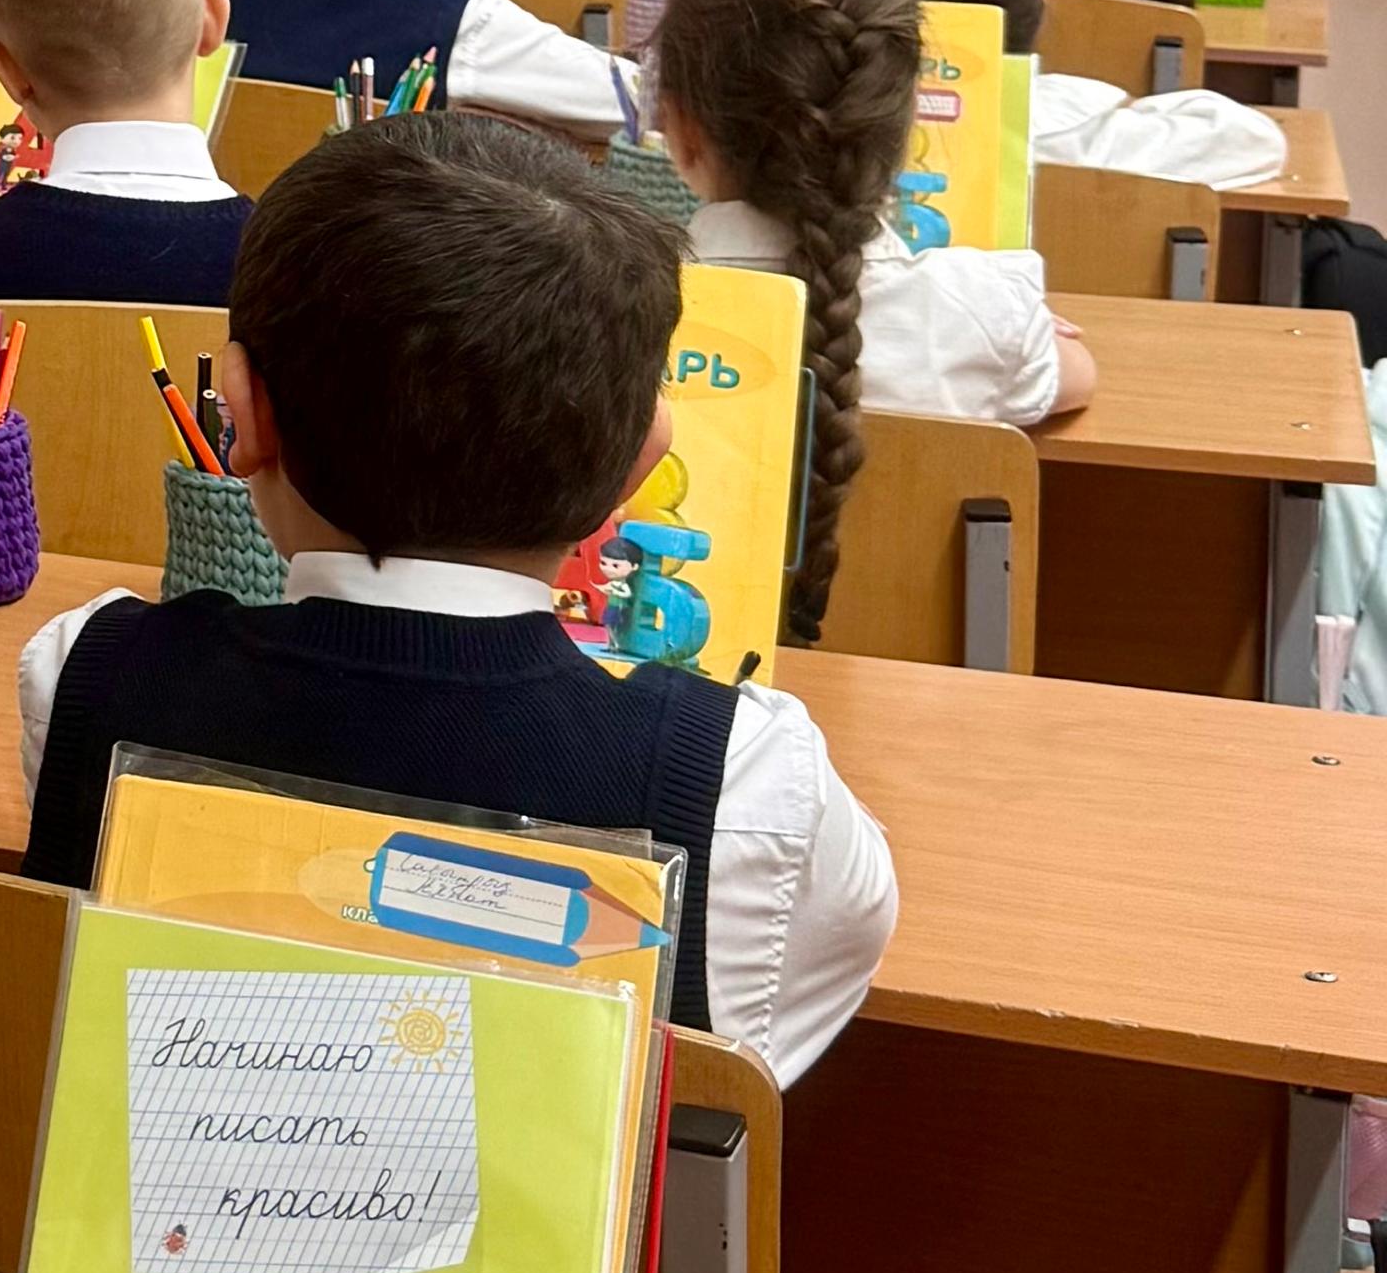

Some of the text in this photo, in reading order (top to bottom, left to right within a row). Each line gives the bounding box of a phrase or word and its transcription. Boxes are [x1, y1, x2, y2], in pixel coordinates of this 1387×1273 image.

[342, 904, 378, 924] кла
[151, 1017, 373, 1073] Начинаю
[189, 1114, 369, 1147] писать
[217, 1168, 443, 1240] красиво!
